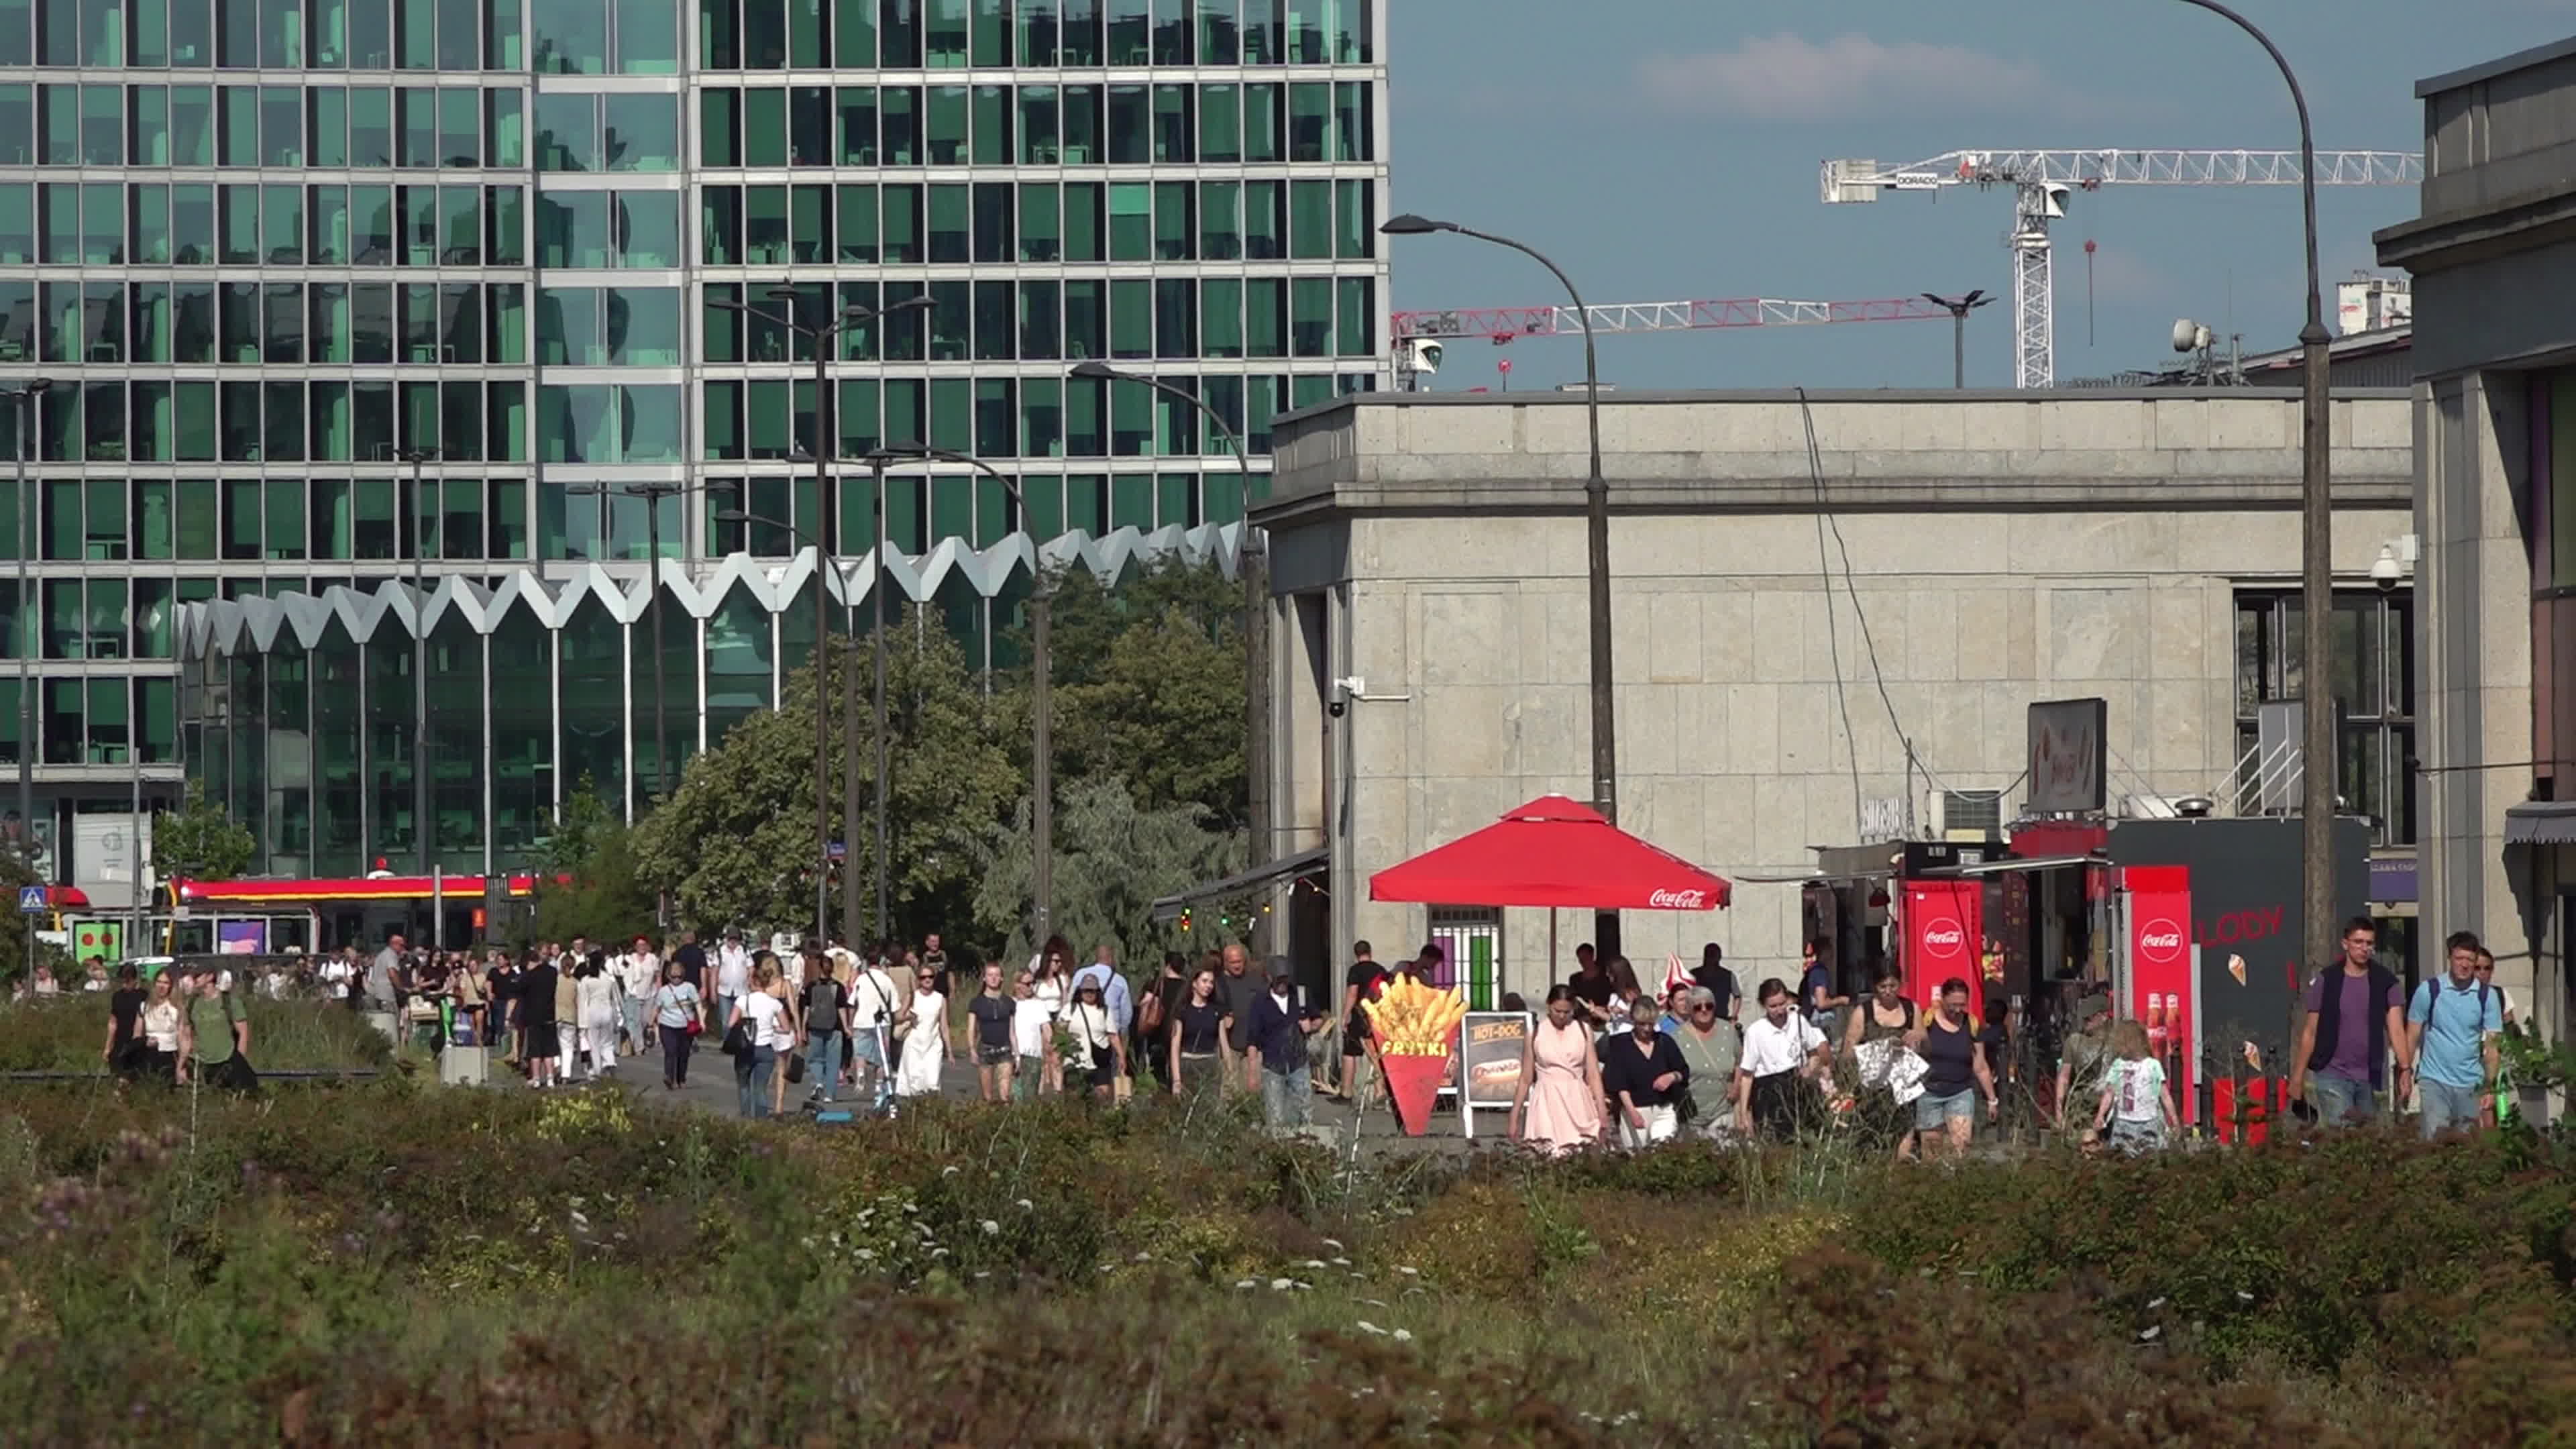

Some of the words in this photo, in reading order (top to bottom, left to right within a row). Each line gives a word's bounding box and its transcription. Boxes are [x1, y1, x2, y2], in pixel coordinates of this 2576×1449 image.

[2196, 904, 2284, 949] LODY
[1473, 1023, 1521, 1040] HOT-DOG
[1381, 1040, 1447, 1057] FRYTKI
